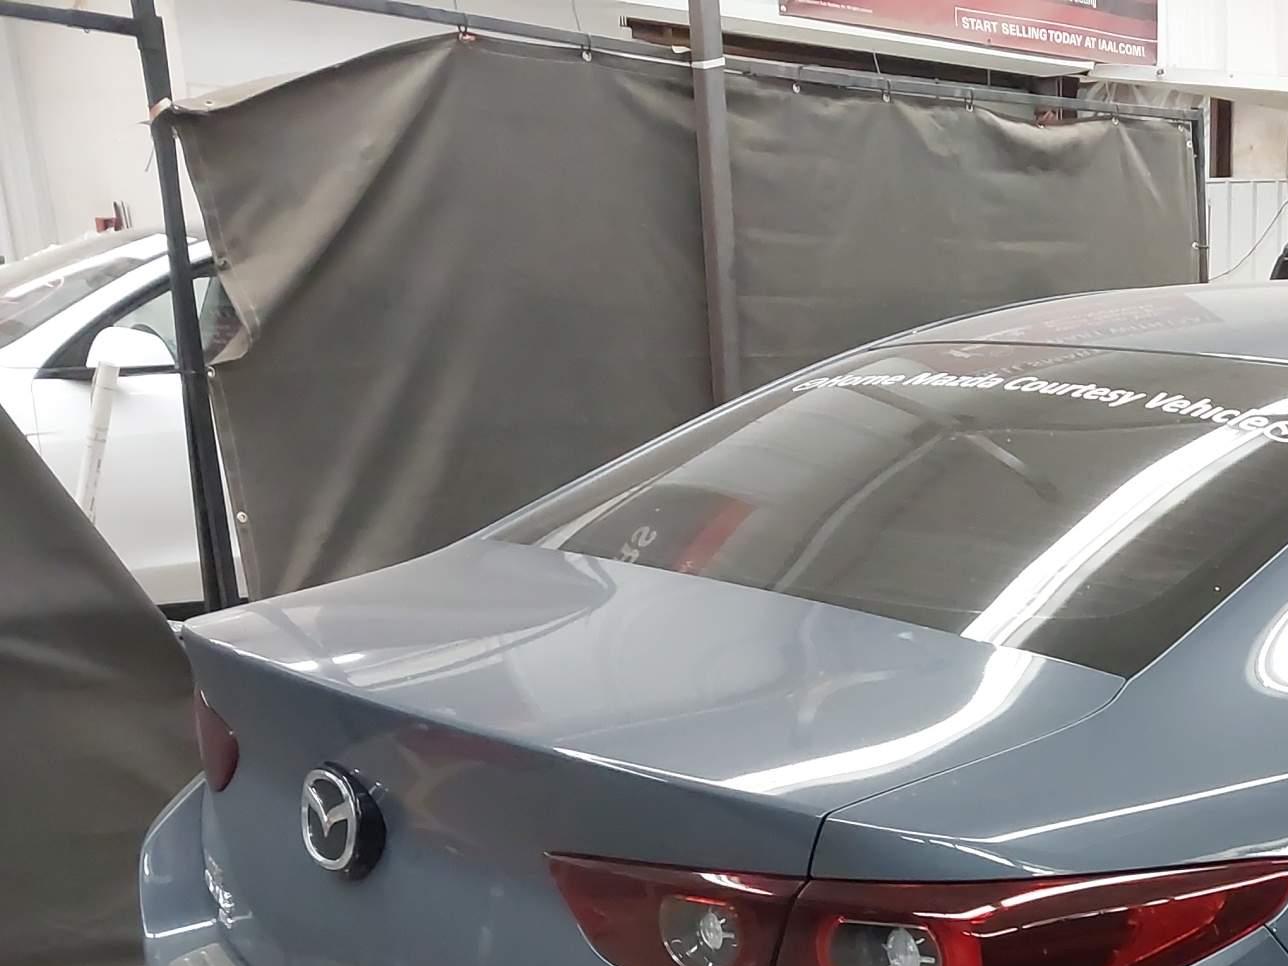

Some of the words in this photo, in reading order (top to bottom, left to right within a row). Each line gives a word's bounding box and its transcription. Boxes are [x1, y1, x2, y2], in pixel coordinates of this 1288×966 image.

[962, 16, 998, 33] START
[1001, 22, 1047, 40] SELLING
[1048, 29, 1083, 48] TODAY
[1084, 37, 1097, 49] AT
[902, 372, 1004, 389] Mazda
[1004, 376, 1147, 408] Courtesy
[1145, 392, 1270, 431] Vehicle
